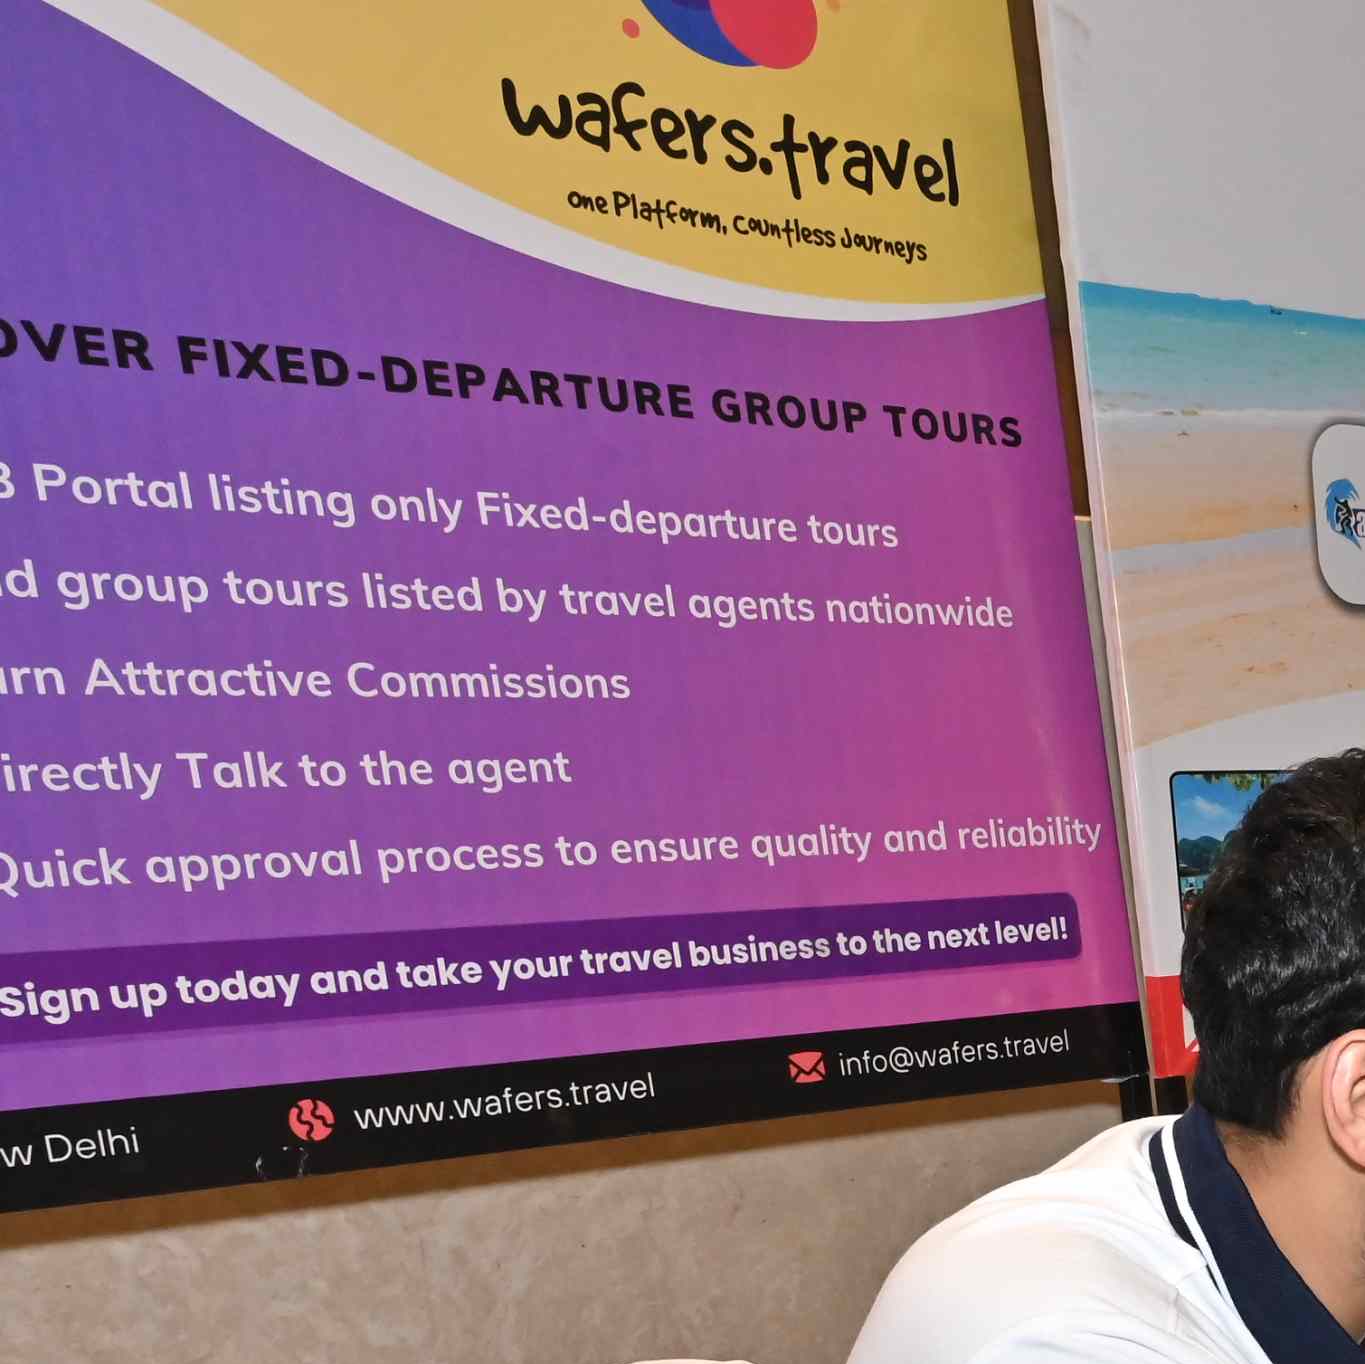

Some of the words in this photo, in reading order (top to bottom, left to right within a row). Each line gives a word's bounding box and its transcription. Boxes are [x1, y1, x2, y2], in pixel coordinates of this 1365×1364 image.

[499, 76, 962, 208] wafers.travel
[612, 190, 728, 235] Platform,
[840, 226, 928, 264] Journeys
[176, 335, 695, 420] FIXED-DEPARTURE
[712, 388, 868, 434] GROUP
[883, 404, 1024, 448] TOURS
[32, 462, 194, 510] Portal
[208, 472, 357, 529] listing
[370, 486, 463, 534] only
[476, 490, 799, 548] Fixed-departure
[806, 511, 900, 549] tours
[56, 570, 209, 613] group
[222, 570, 349, 609] tours
[361, 572, 486, 613] listed
[496, 576, 546, 622] by
[559, 580, 677, 619] travel
[687, 588, 816, 629] agents
[825, 594, 1015, 630] nationwide
[0, 666, 66, 696] rn
[84, 658, 333, 697] Attractive
[346, 661, 631, 700] Commissions
[176, 750, 288, 789] Talk
[298, 753, 347, 787] to
[360, 750, 434, 786] the
[448, 750, 572, 792] agent
[145, 838, 362, 892] approval
[377, 836, 543, 877] process
[554, 832, 598, 867] to
[609, 830, 741, 866] ensure
[751, 819, 874, 864] quality
[884, 817, 947, 853] and
[956, 815, 1102, 858] reliability
[0, 981, 100, 1026] Sign
[110, 982, 168, 1018] up
[175, 970, 301, 1008] today
[310, 960, 389, 995] and
[396, 956, 484, 990] take
[490, 949, 573, 989] your
[579, 940, 682, 975] travel
[689, 931, 831, 967] business
[836, 928, 868, 956] to
[873, 925, 921, 954] the
[928, 921, 990, 949] next
[994, 915, 1069, 944] level!
[838, 1028, 1070, 1078] info@wafers.travel
[353, 1071, 655, 1131] www.wafers.travel
[45, 1126, 140, 1163] Delhi
